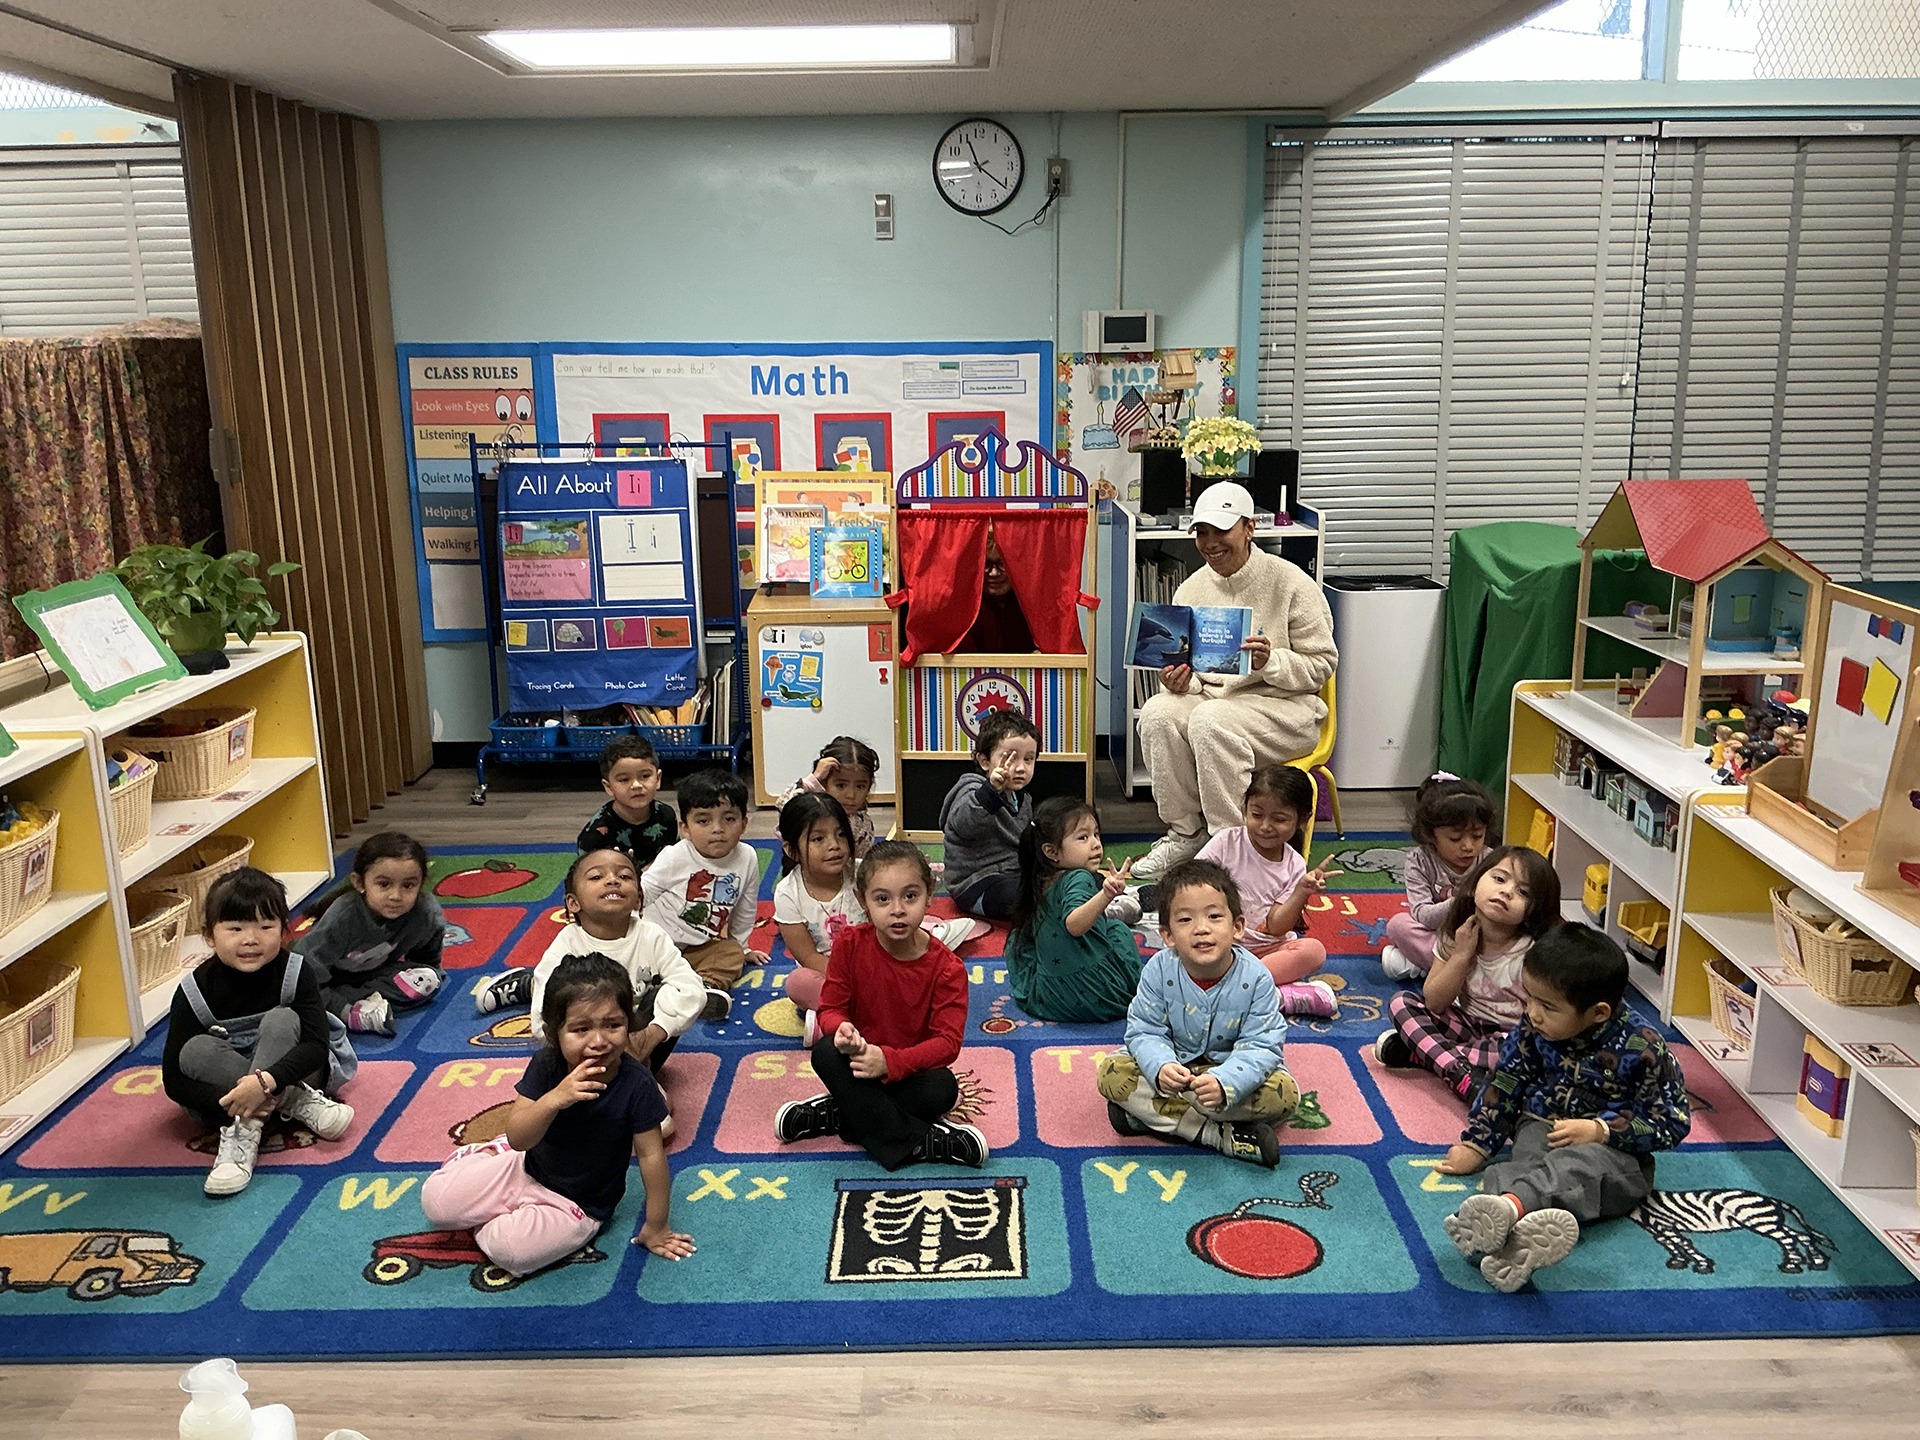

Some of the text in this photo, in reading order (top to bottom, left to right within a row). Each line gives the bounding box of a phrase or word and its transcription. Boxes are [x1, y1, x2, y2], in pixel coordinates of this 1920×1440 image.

[959, 133, 969, 144] 11
[974, 128, 985, 139] 12
[949, 146, 961, 157] 10
[1004, 145, 1010, 156] 2
[1007, 161, 1014, 172] 3
[961, 189, 967, 200] 7
[976, 193, 982, 203] 6
[991, 189, 997, 199] 5
[424, 366, 518, 380] CLASS RULES
[556, 360, 574, 373] Can
[580, 364, 592, 376] you
[598, 362, 613, 374] tell
[633, 363, 646, 374] how
[652, 368, 662, 377] you
[752, 365, 849, 396] Math
[1112, 367, 1156, 384] HAP
[415, 401, 490, 414] Look with Eyes
[419, 430, 469, 443] Listening
[421, 473, 450, 485] Quiet
[517, 475, 547, 495] All
[555, 473, 612, 495] About
[629, 474, 641, 494] Ii
[425, 506, 468, 520] Helping
[839, 517, 863, 527] Feels
[428, 539, 471, 551] Walking
[665, 673, 688, 682] Letter
[527, 681, 575, 693] Tracing Cards
[605, 680, 648, 690] Photo Cards
[665, 682, 687, 691] Cards
[977, 684, 983, 692] 11
[988, 681, 997, 689] 12
[967, 694, 976, 702] 10
[1012, 694, 1018, 702] 2
[965, 705, 971, 713] 9
[969, 717, 975, 725] 8
[686, 1169, 789, 1202] Xx
[1094, 1161, 1188, 1203] Yy
[0, 1183, 88, 1216] Vv
